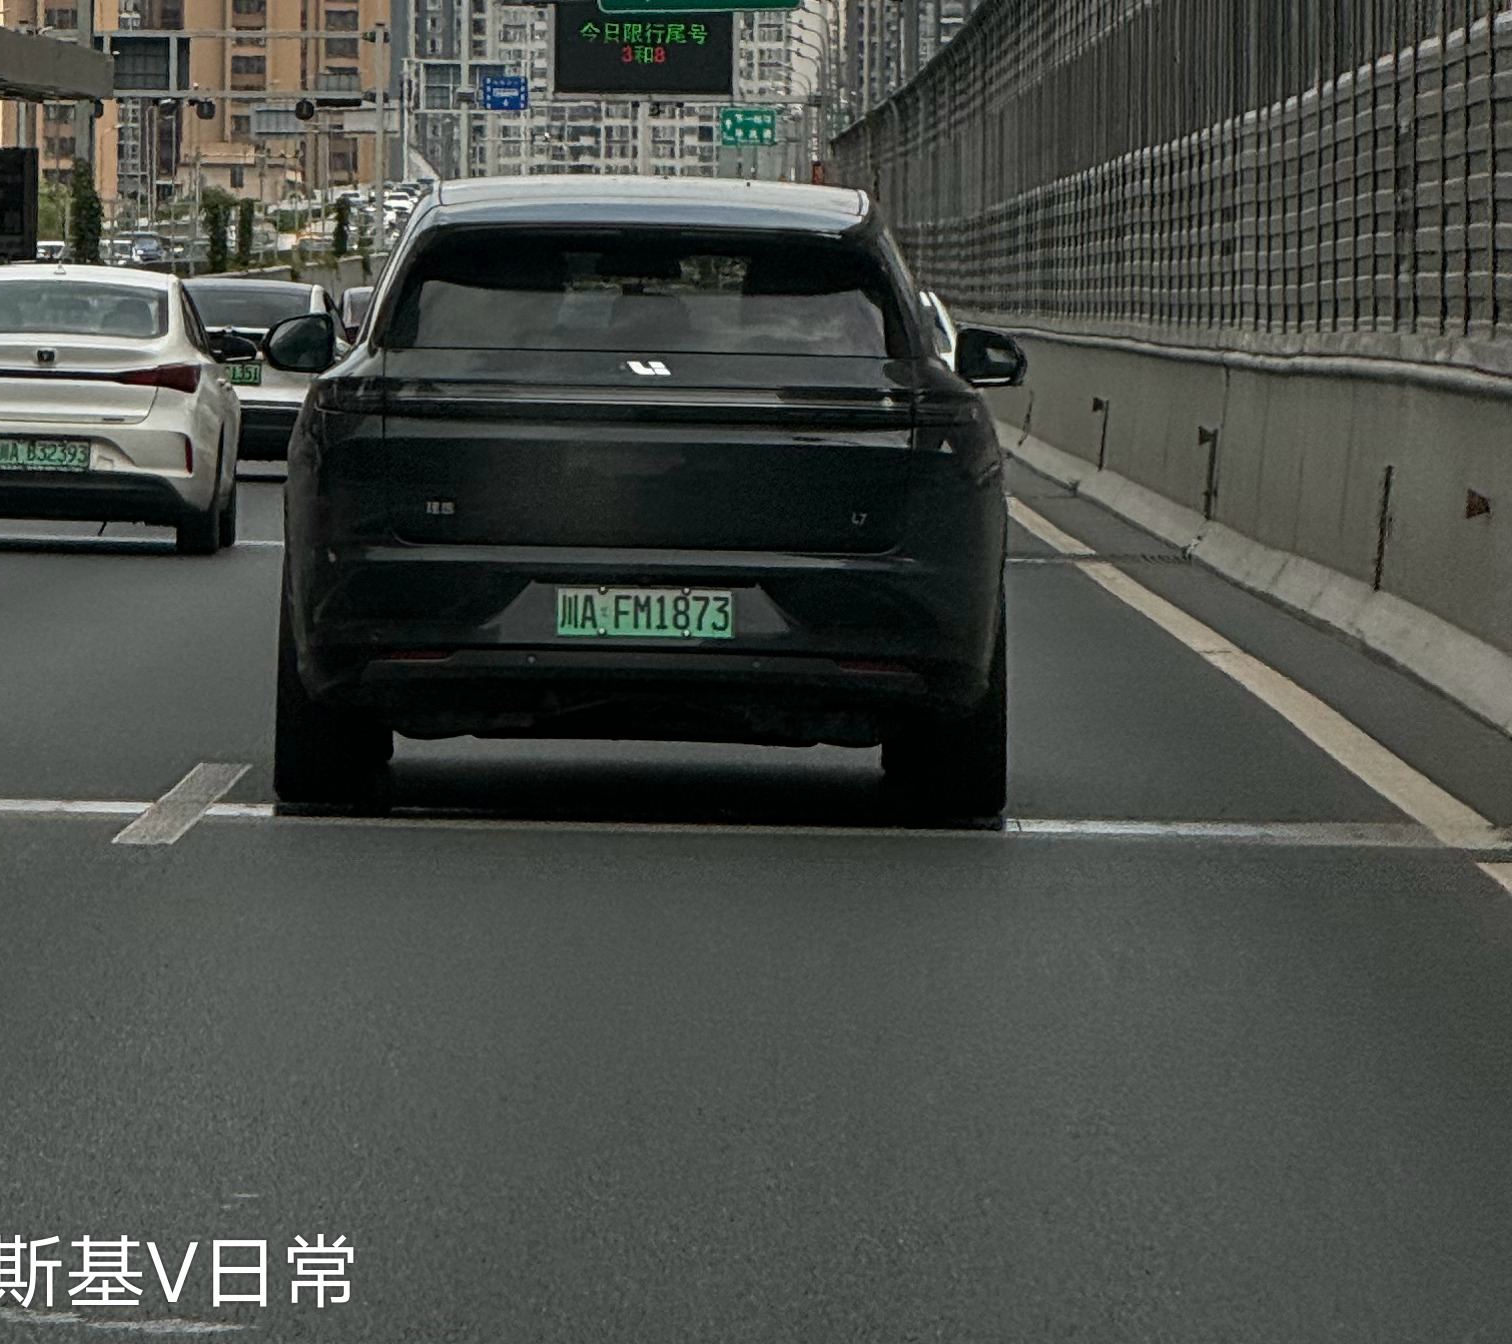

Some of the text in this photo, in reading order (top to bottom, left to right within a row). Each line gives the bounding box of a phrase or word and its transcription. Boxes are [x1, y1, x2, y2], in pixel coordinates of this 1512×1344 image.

[580, 21, 709, 45] 今日限行尾号
